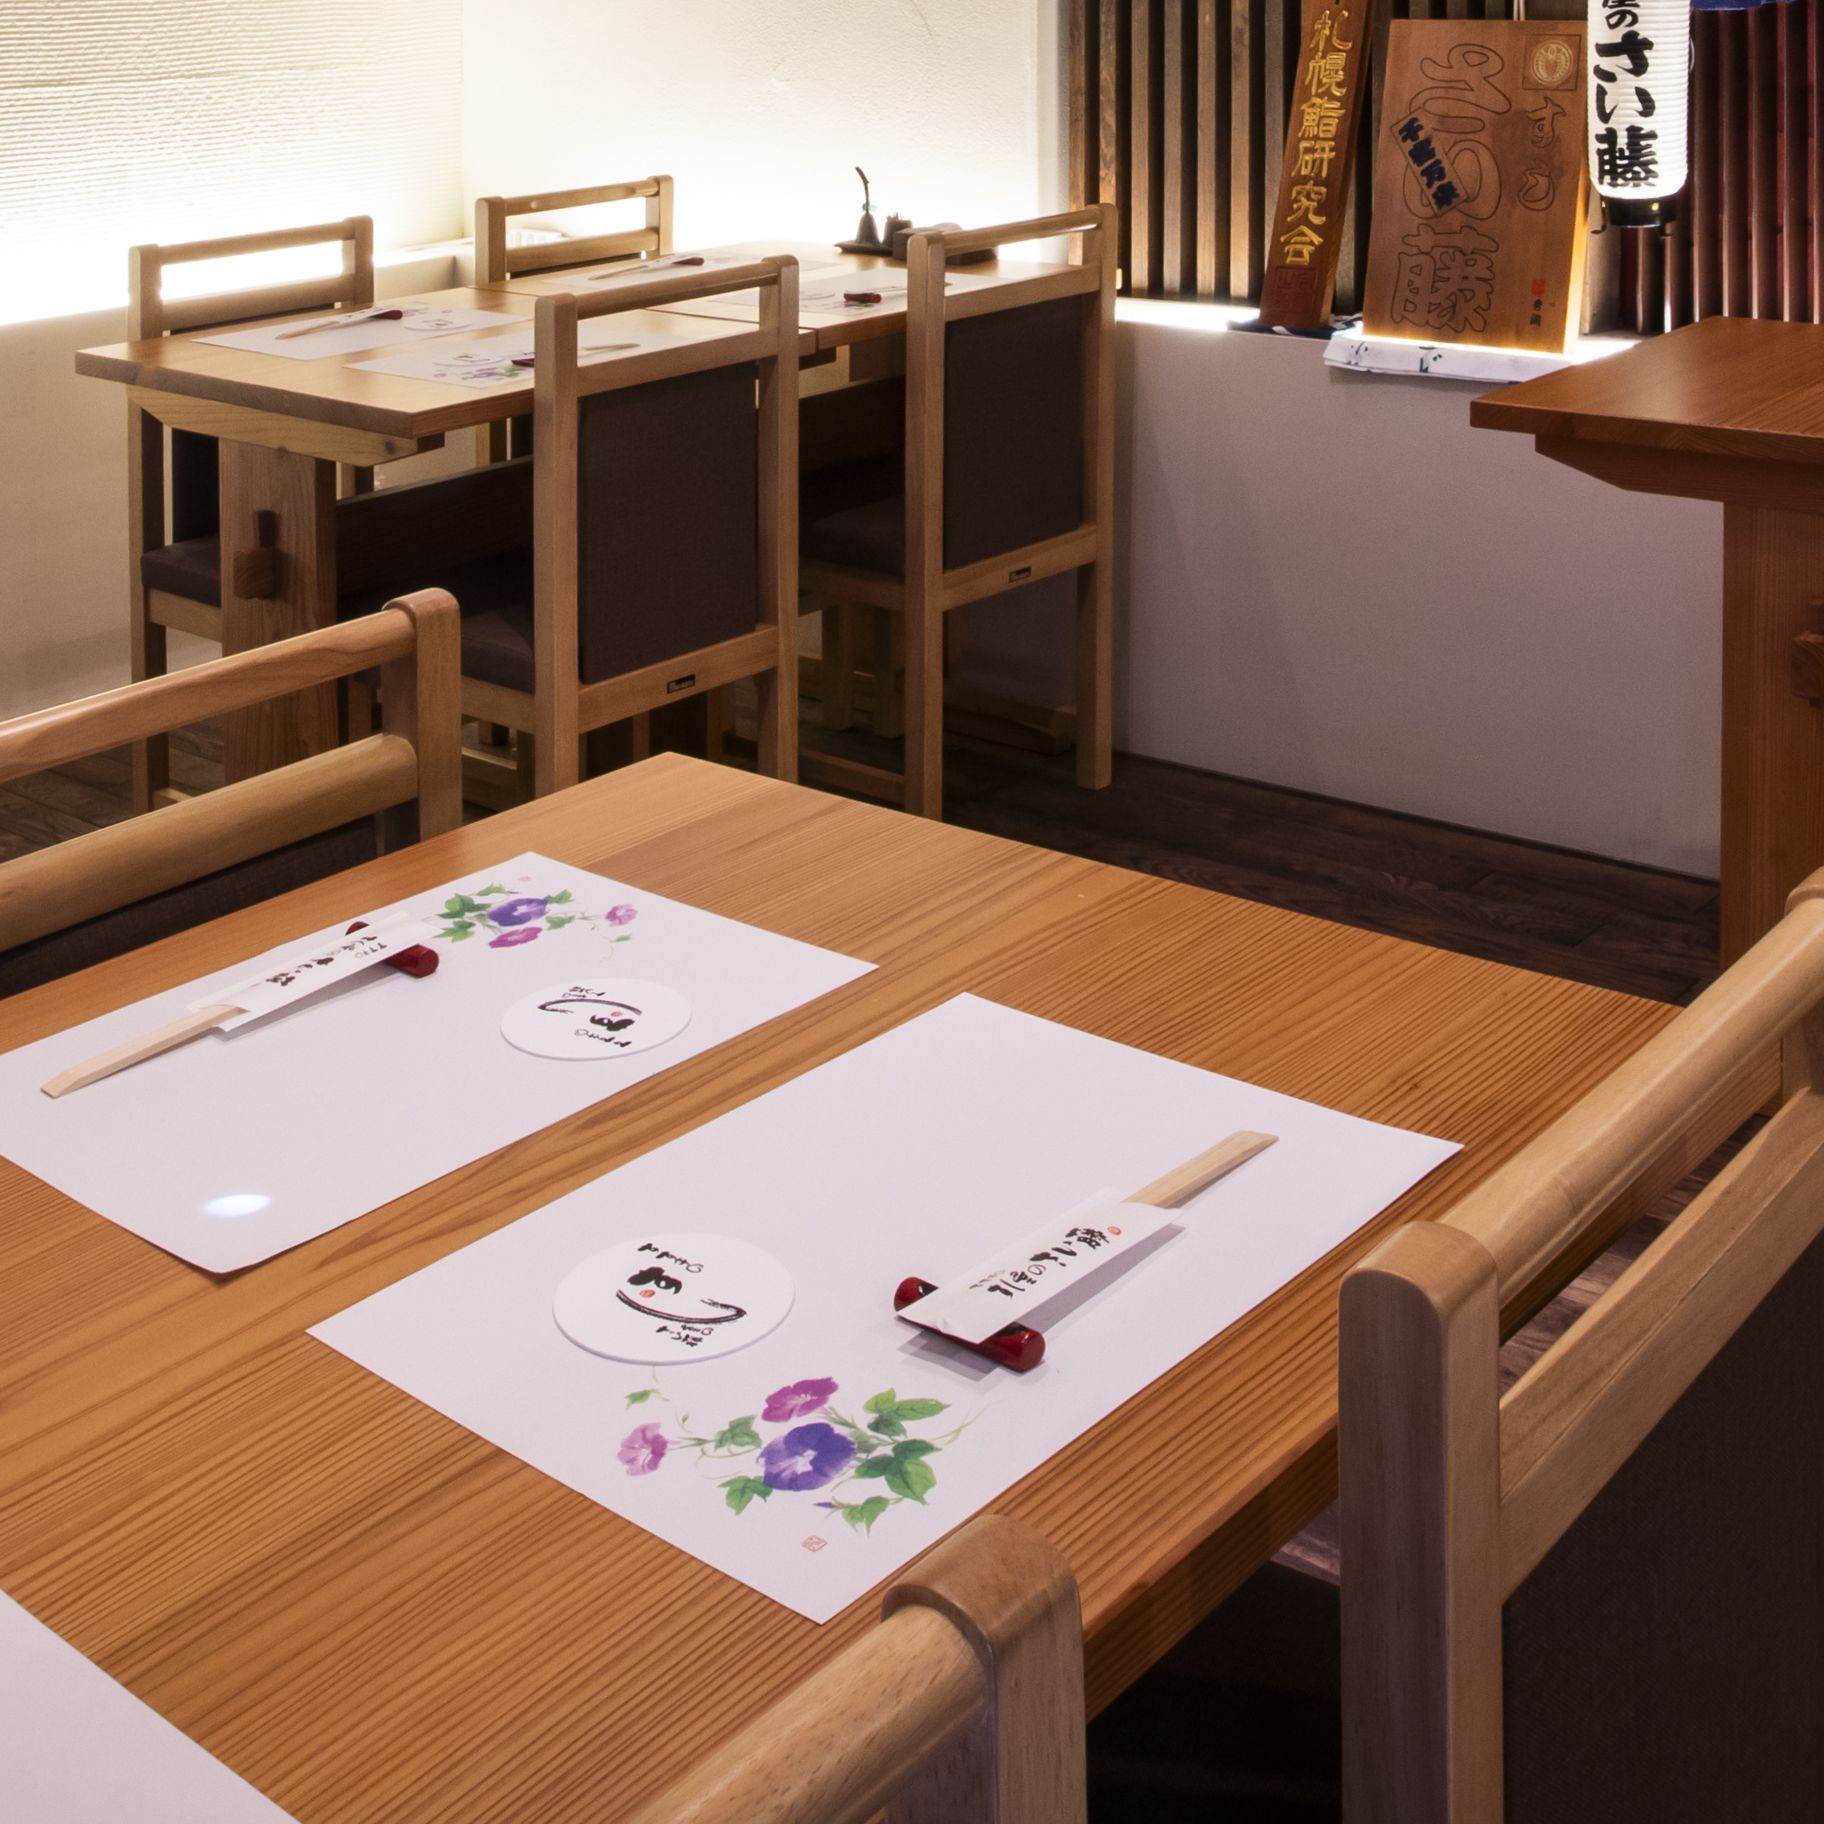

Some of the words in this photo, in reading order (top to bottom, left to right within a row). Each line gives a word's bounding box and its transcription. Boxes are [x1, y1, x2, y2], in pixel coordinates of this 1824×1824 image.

[1279, 9, 1353, 266] 札幌鮨研究会
